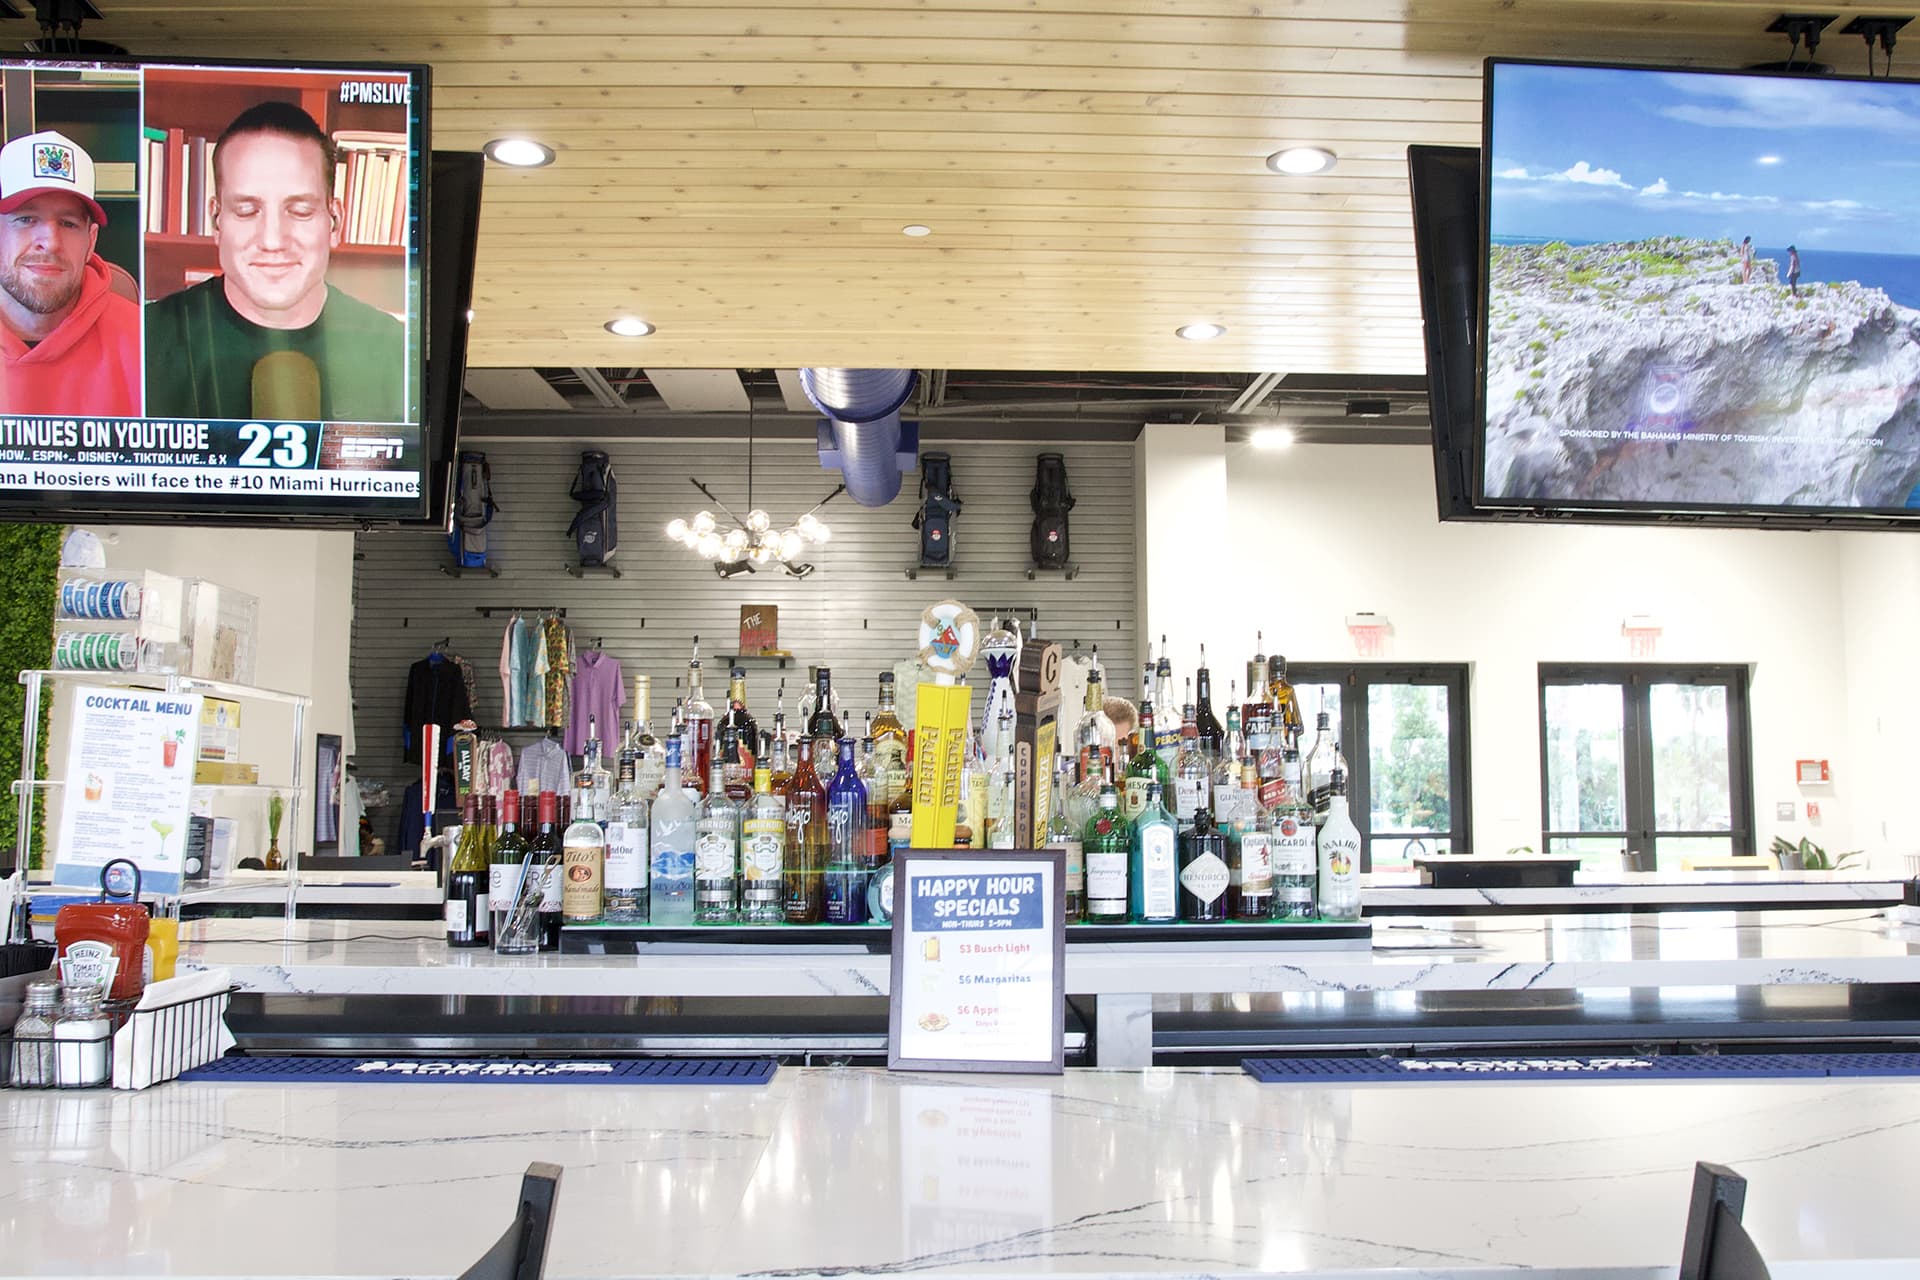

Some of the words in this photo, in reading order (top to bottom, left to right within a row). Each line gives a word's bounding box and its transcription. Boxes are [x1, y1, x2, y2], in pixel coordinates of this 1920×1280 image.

[340, 81, 411, 104] #PMSLIVE
[0, 419, 78, 447] TINUES
[82, 420, 111, 448] ON
[114, 422, 210, 450] YOUTUBE
[1559, 429, 1609, 439] SPONSORED
[1611, 430, 1622, 440] BY
[1623, 430, 1639, 440] THE
[1641, 431, 1682, 441] BAHAMAS
[1683, 432, 1720, 442] MINISTRY
[1721, 433, 1732, 442] OF
[238, 423, 308, 468] 23
[341, 437, 404, 459] ESPN
[133, 452, 174, 465] TIKTOK
[208, 454, 218, 465] &
[219, 454, 228, 465] X
[34, 470, 111, 487] Hoosiers
[116, 472, 145, 487] will
[152, 472, 190, 488] face
[196, 474, 223, 489] the
[229, 475, 263, 490] #10
[270, 476, 323, 491] Miami
[86, 695, 151, 712] COCKTAIL
[156, 701, 193, 716] MENU
[1246, 721, 1271, 734] CAMP
[919, 725, 940, 807] PACIFICO
[943, 727, 964, 808] PACIFICO
[566, 850, 598, 863] Tito's
[918, 878, 980, 897] HAPPY
[986, 876, 1035, 895] HOUR
[934, 898, 1020, 918] SPECIALS
[75, 949, 101, 959] HEINZ
[974, 943, 1004, 954] Busch
[1006, 943, 1030, 955] Light
[73, 963, 103, 972] TOMATO
[974, 974, 1032, 986] Margaritas
